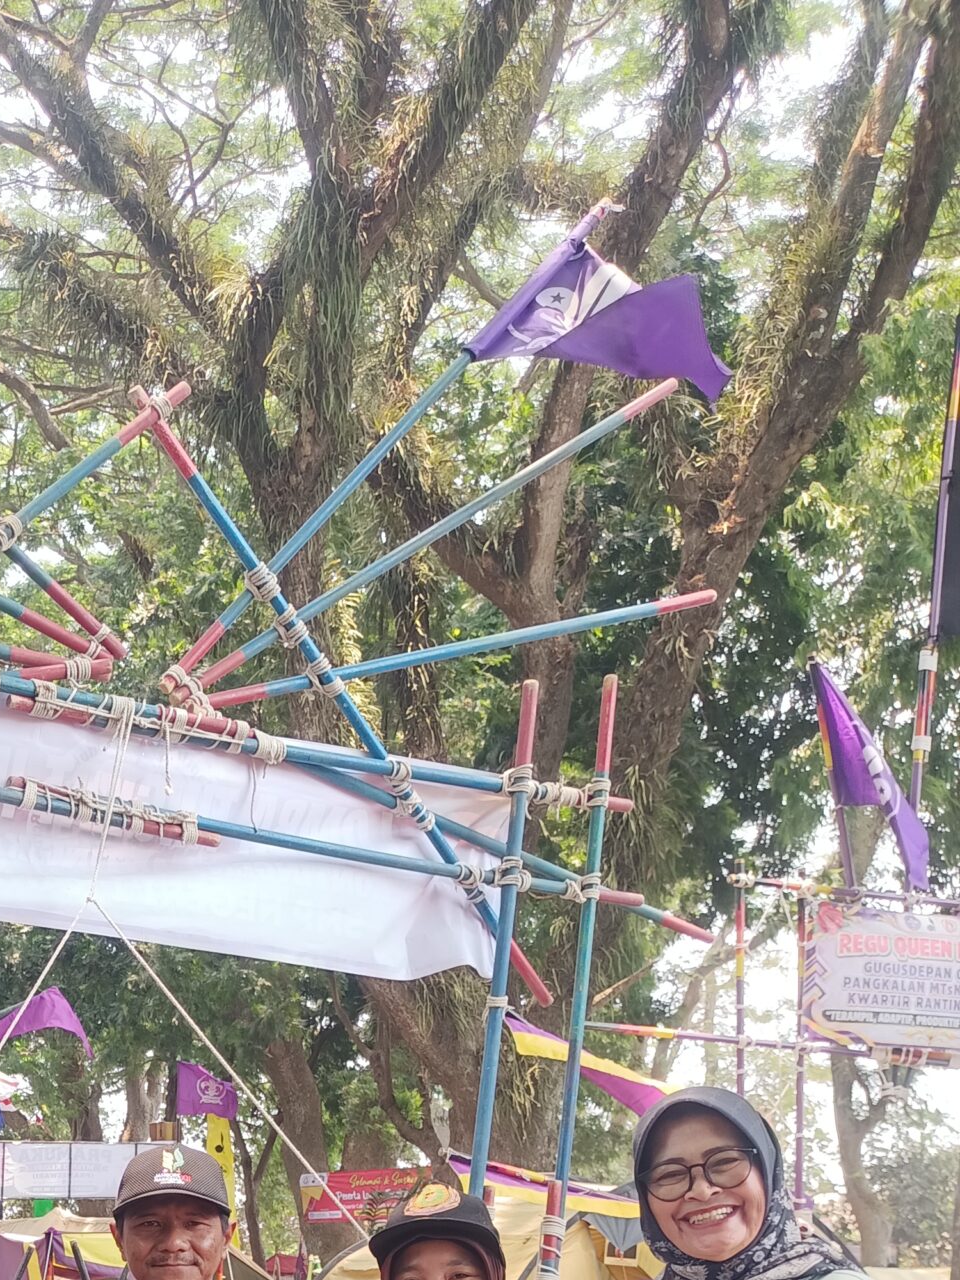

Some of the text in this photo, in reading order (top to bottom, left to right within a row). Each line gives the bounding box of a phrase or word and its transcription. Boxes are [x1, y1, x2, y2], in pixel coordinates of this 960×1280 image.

[839, 933, 889, 954] REGU
[894, 935, 952, 958] QUEEN
[863, 961, 952, 979] GUGUSDEPAN
[843, 976, 925, 993] PANGKALAN
[848, 992, 910, 1008] KWARTIR
